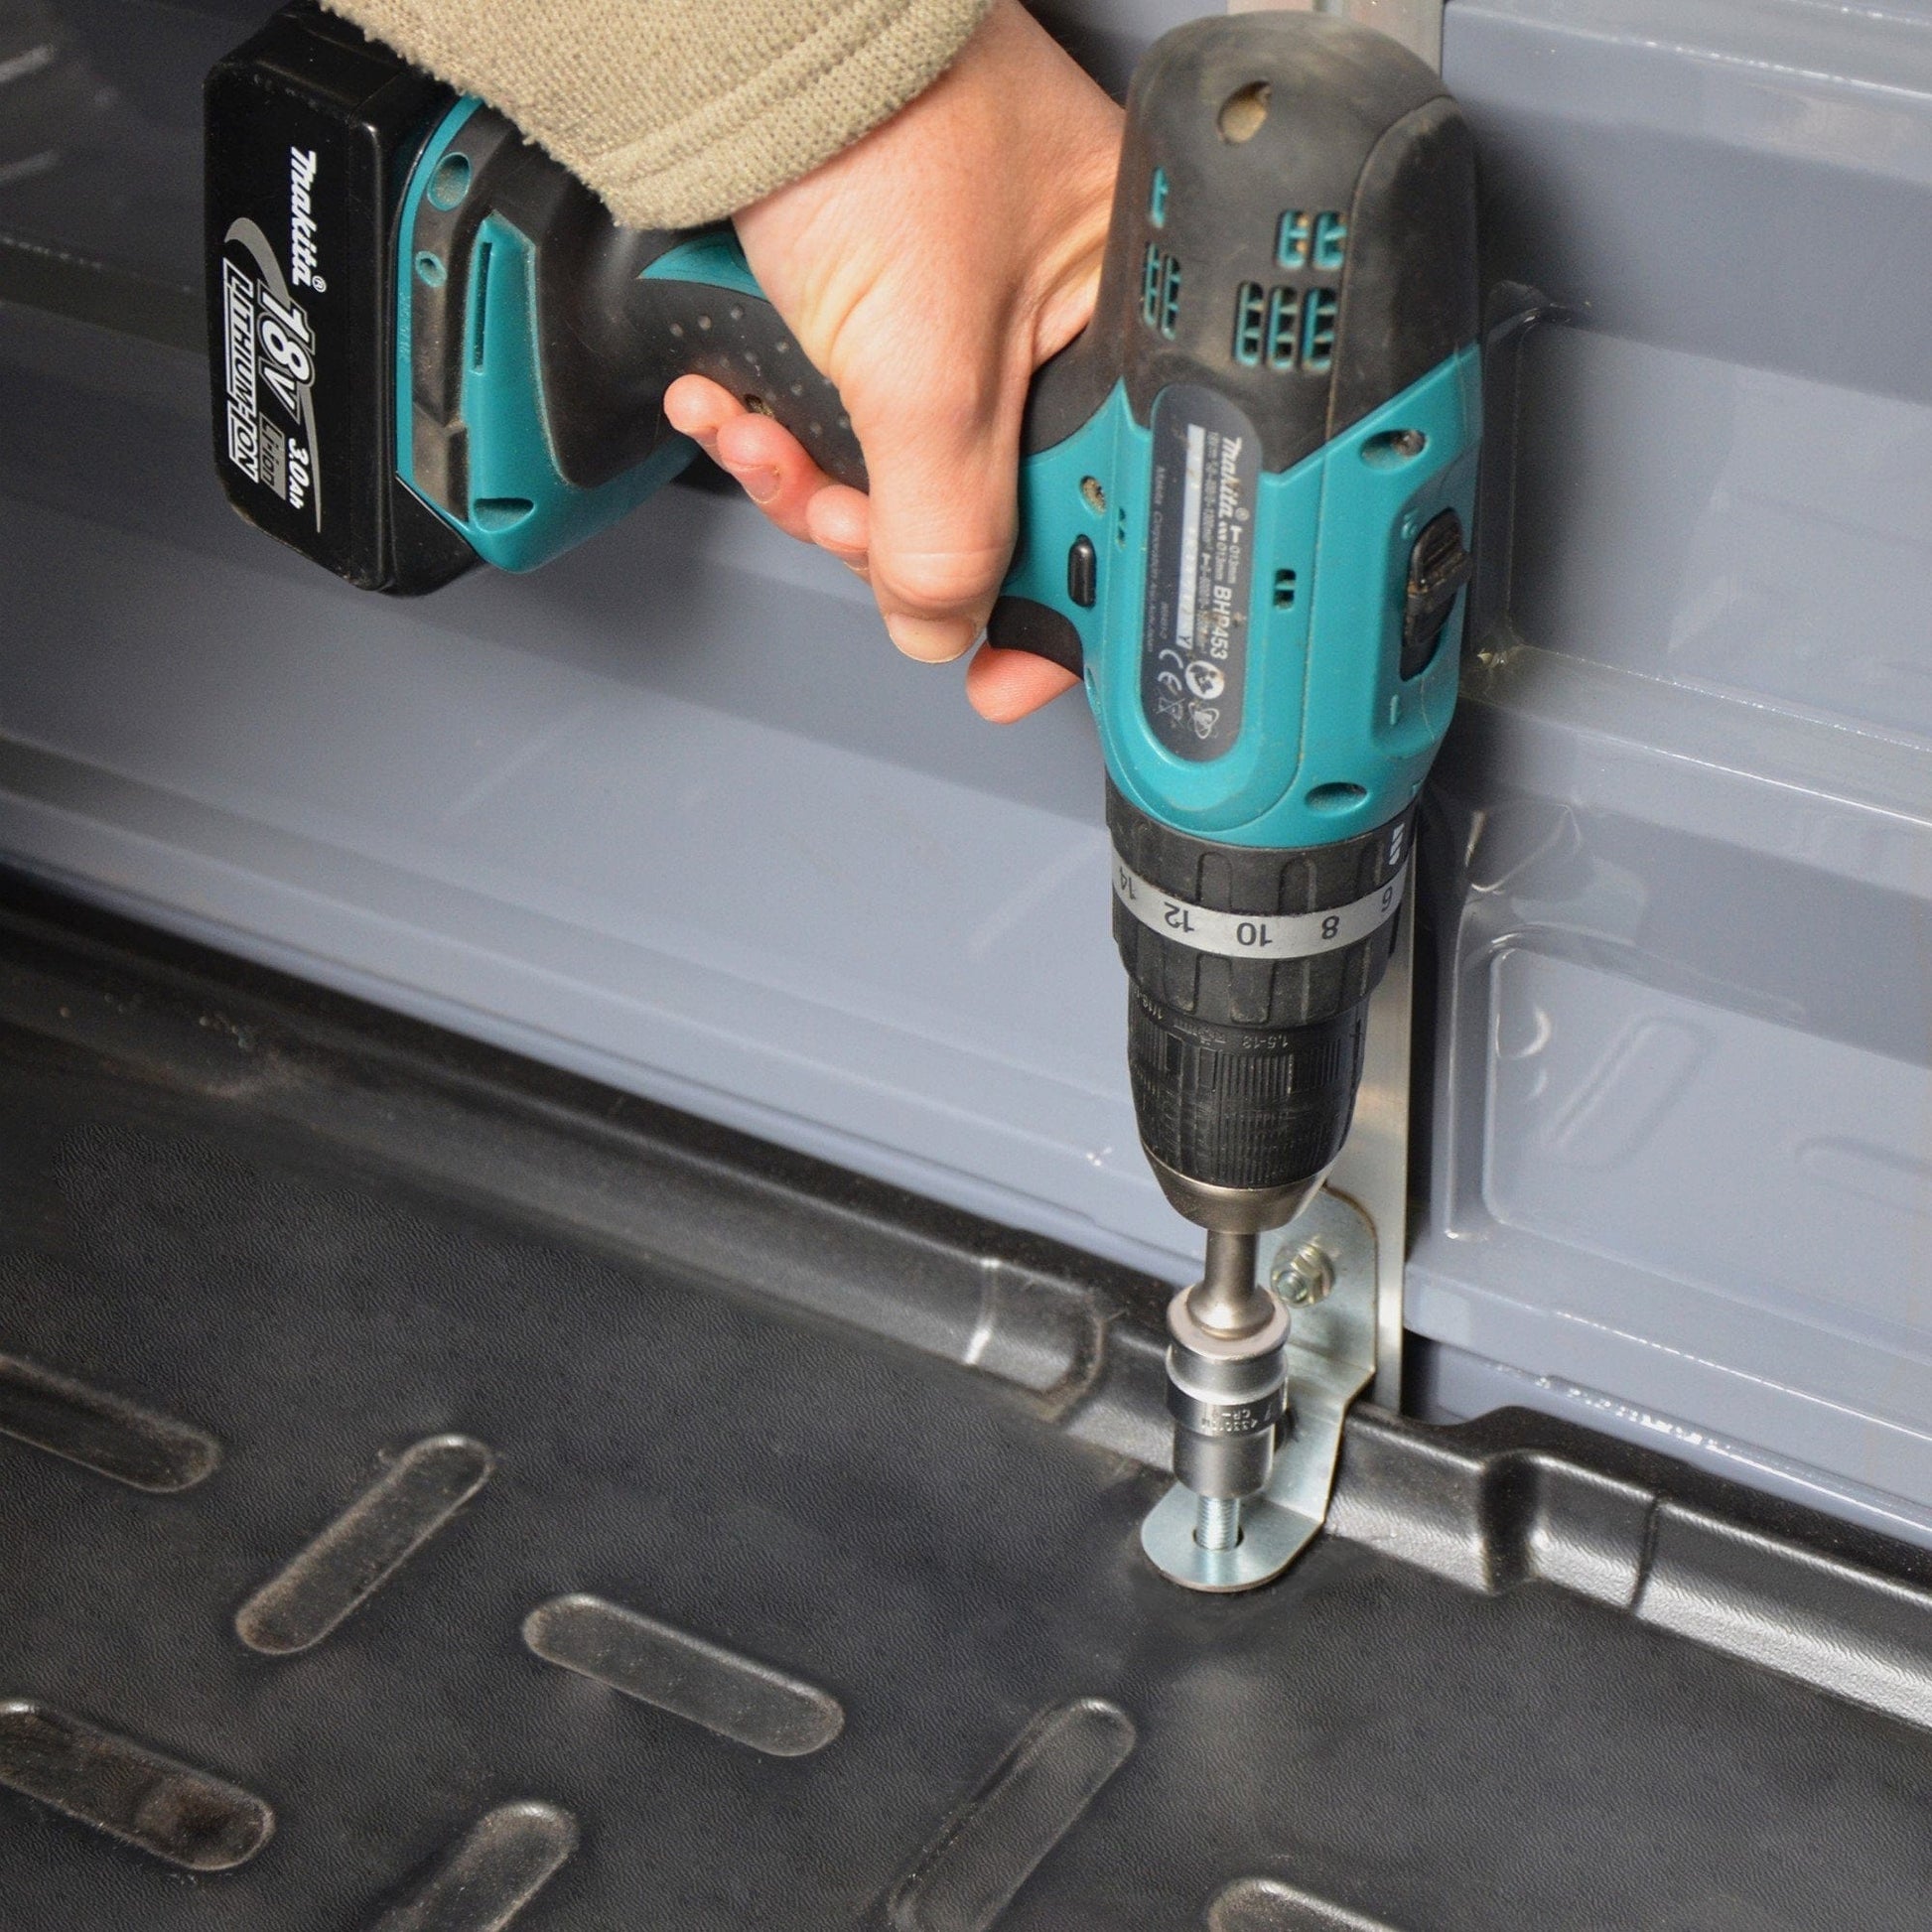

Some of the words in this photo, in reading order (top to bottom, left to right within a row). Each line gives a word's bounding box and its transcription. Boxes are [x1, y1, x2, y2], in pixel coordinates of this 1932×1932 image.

[288, 437, 311, 509] 3.0Ah
[1209, 585, 1232, 660] BHP453
[1164, 901, 1194, 933] 12
[1320, 915, 1340, 940] 8
[1236, 921, 1273, 948] 10
